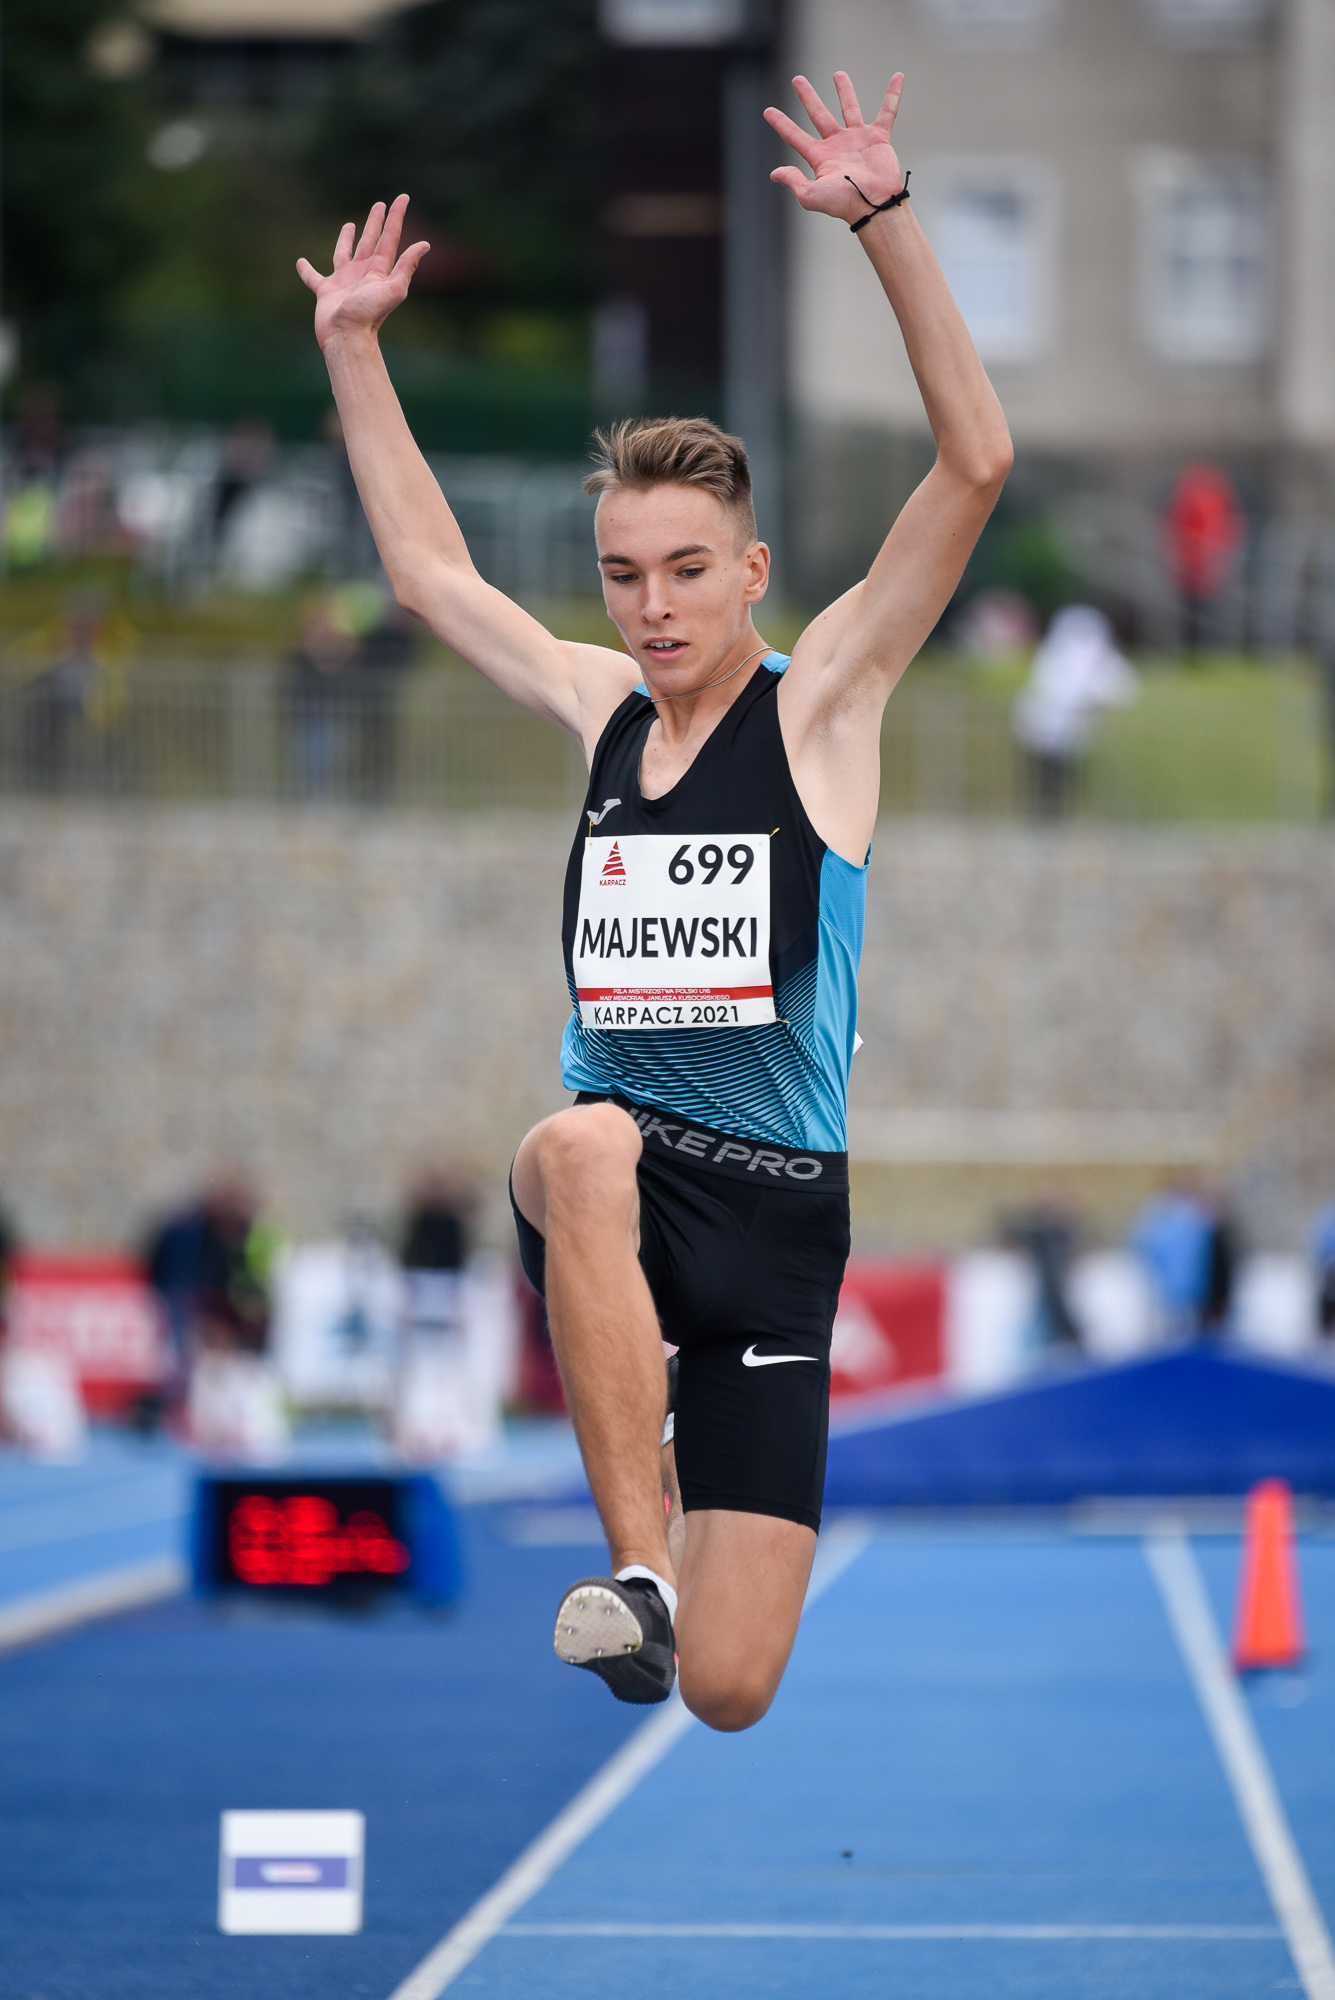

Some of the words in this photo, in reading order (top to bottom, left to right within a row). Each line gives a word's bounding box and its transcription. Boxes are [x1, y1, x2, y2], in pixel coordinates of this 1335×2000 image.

[599, 879, 627, 887] KARPACZ
[668, 843, 755, 885] 699
[579, 917, 758, 959] MAJEWSKI
[594, 1006, 685, 1025] KARPACZ
[691, 1005, 740, 1023] 2021
[712, 1141, 823, 1180] PRO
